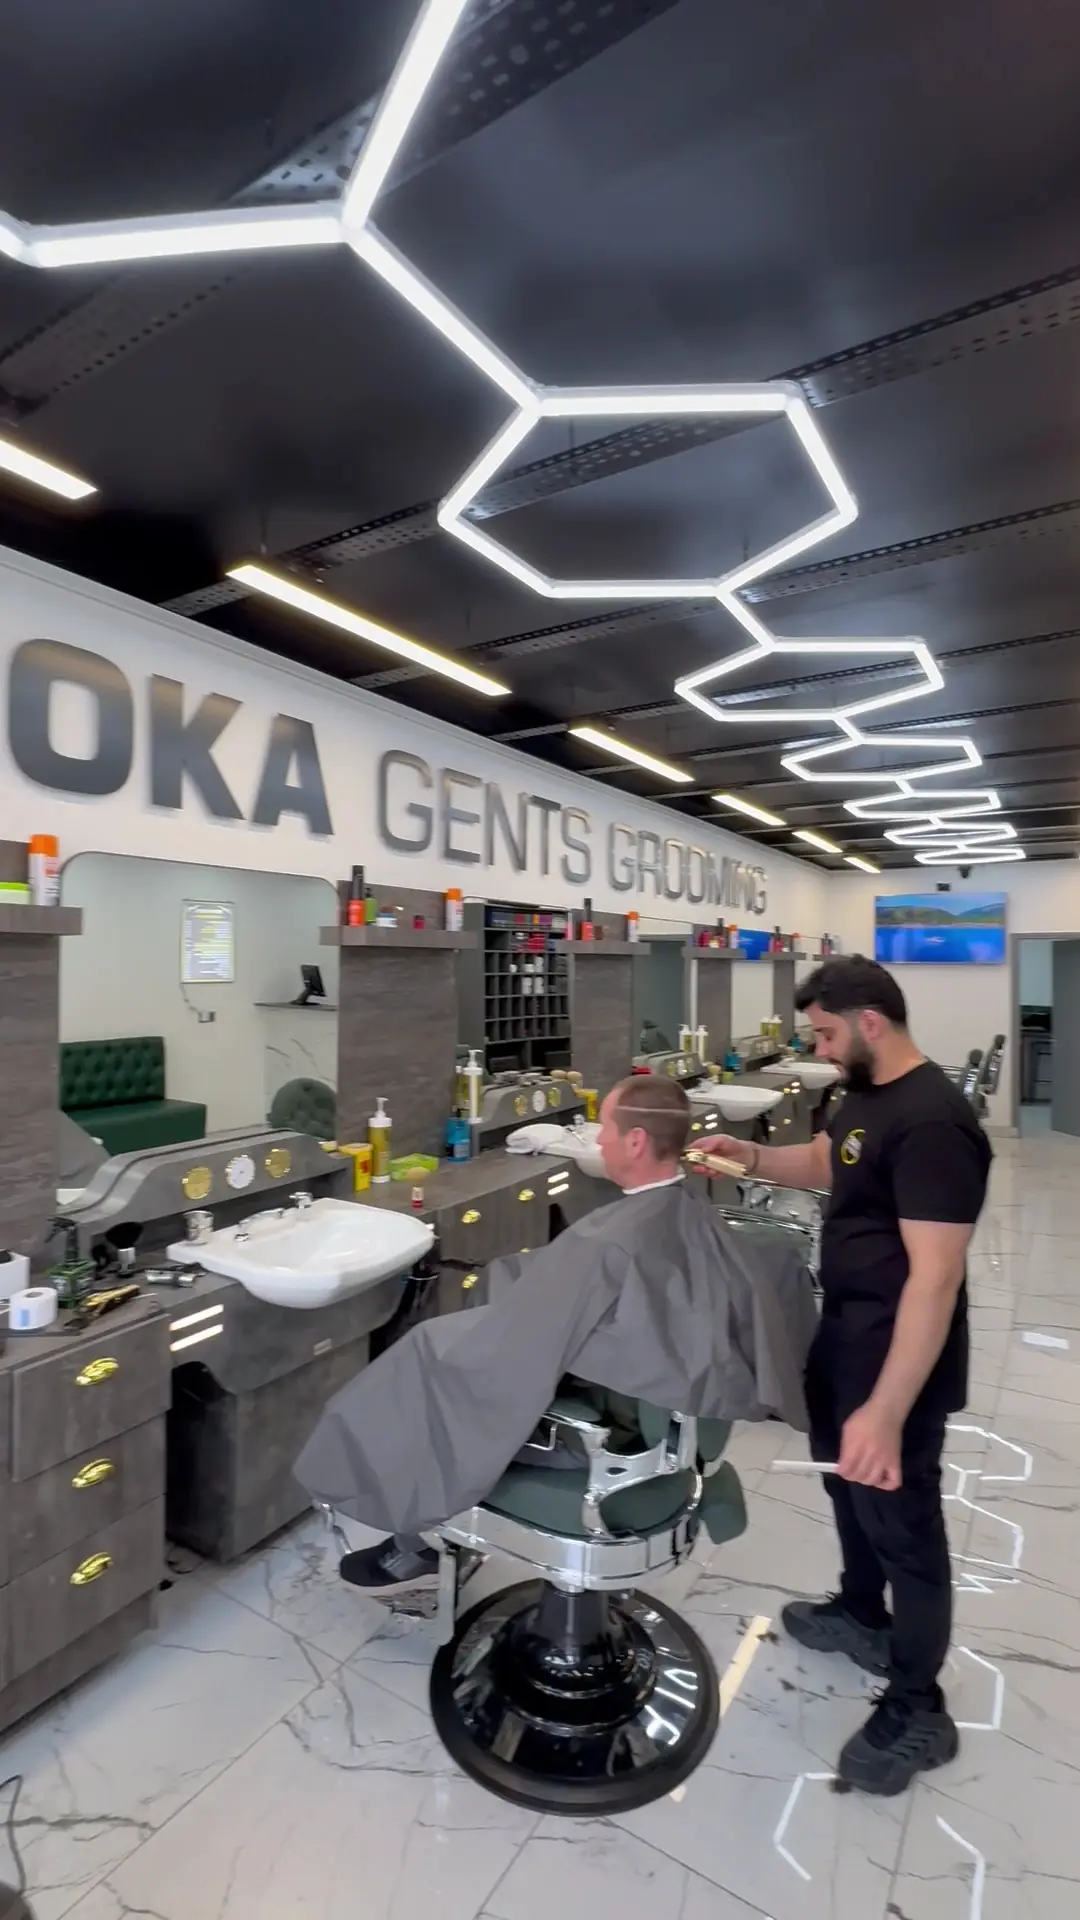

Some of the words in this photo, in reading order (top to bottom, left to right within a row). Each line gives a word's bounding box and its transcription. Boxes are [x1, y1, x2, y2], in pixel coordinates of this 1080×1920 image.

[9, 638, 334, 836] OKA
[378, 749, 592, 883] GENTS
[608, 822, 768, 914] GROOMING
